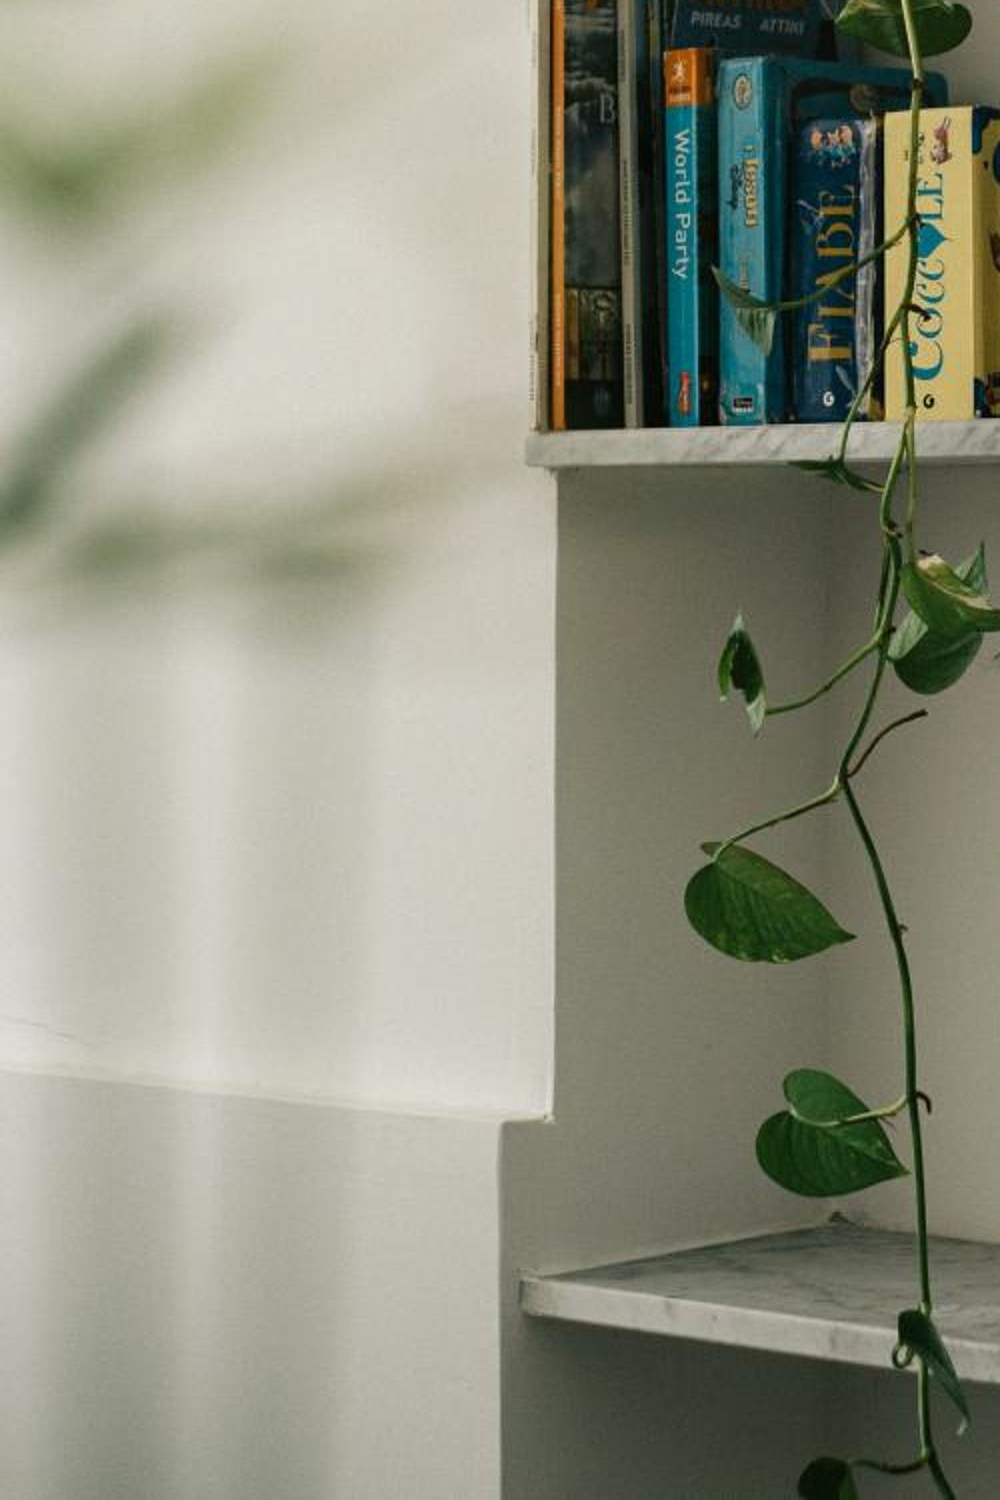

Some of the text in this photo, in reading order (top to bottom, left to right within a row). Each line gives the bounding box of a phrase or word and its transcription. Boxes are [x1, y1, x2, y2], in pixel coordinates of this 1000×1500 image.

[672, 128, 692, 282] World Party
[807, 184, 856, 366] FIABE
